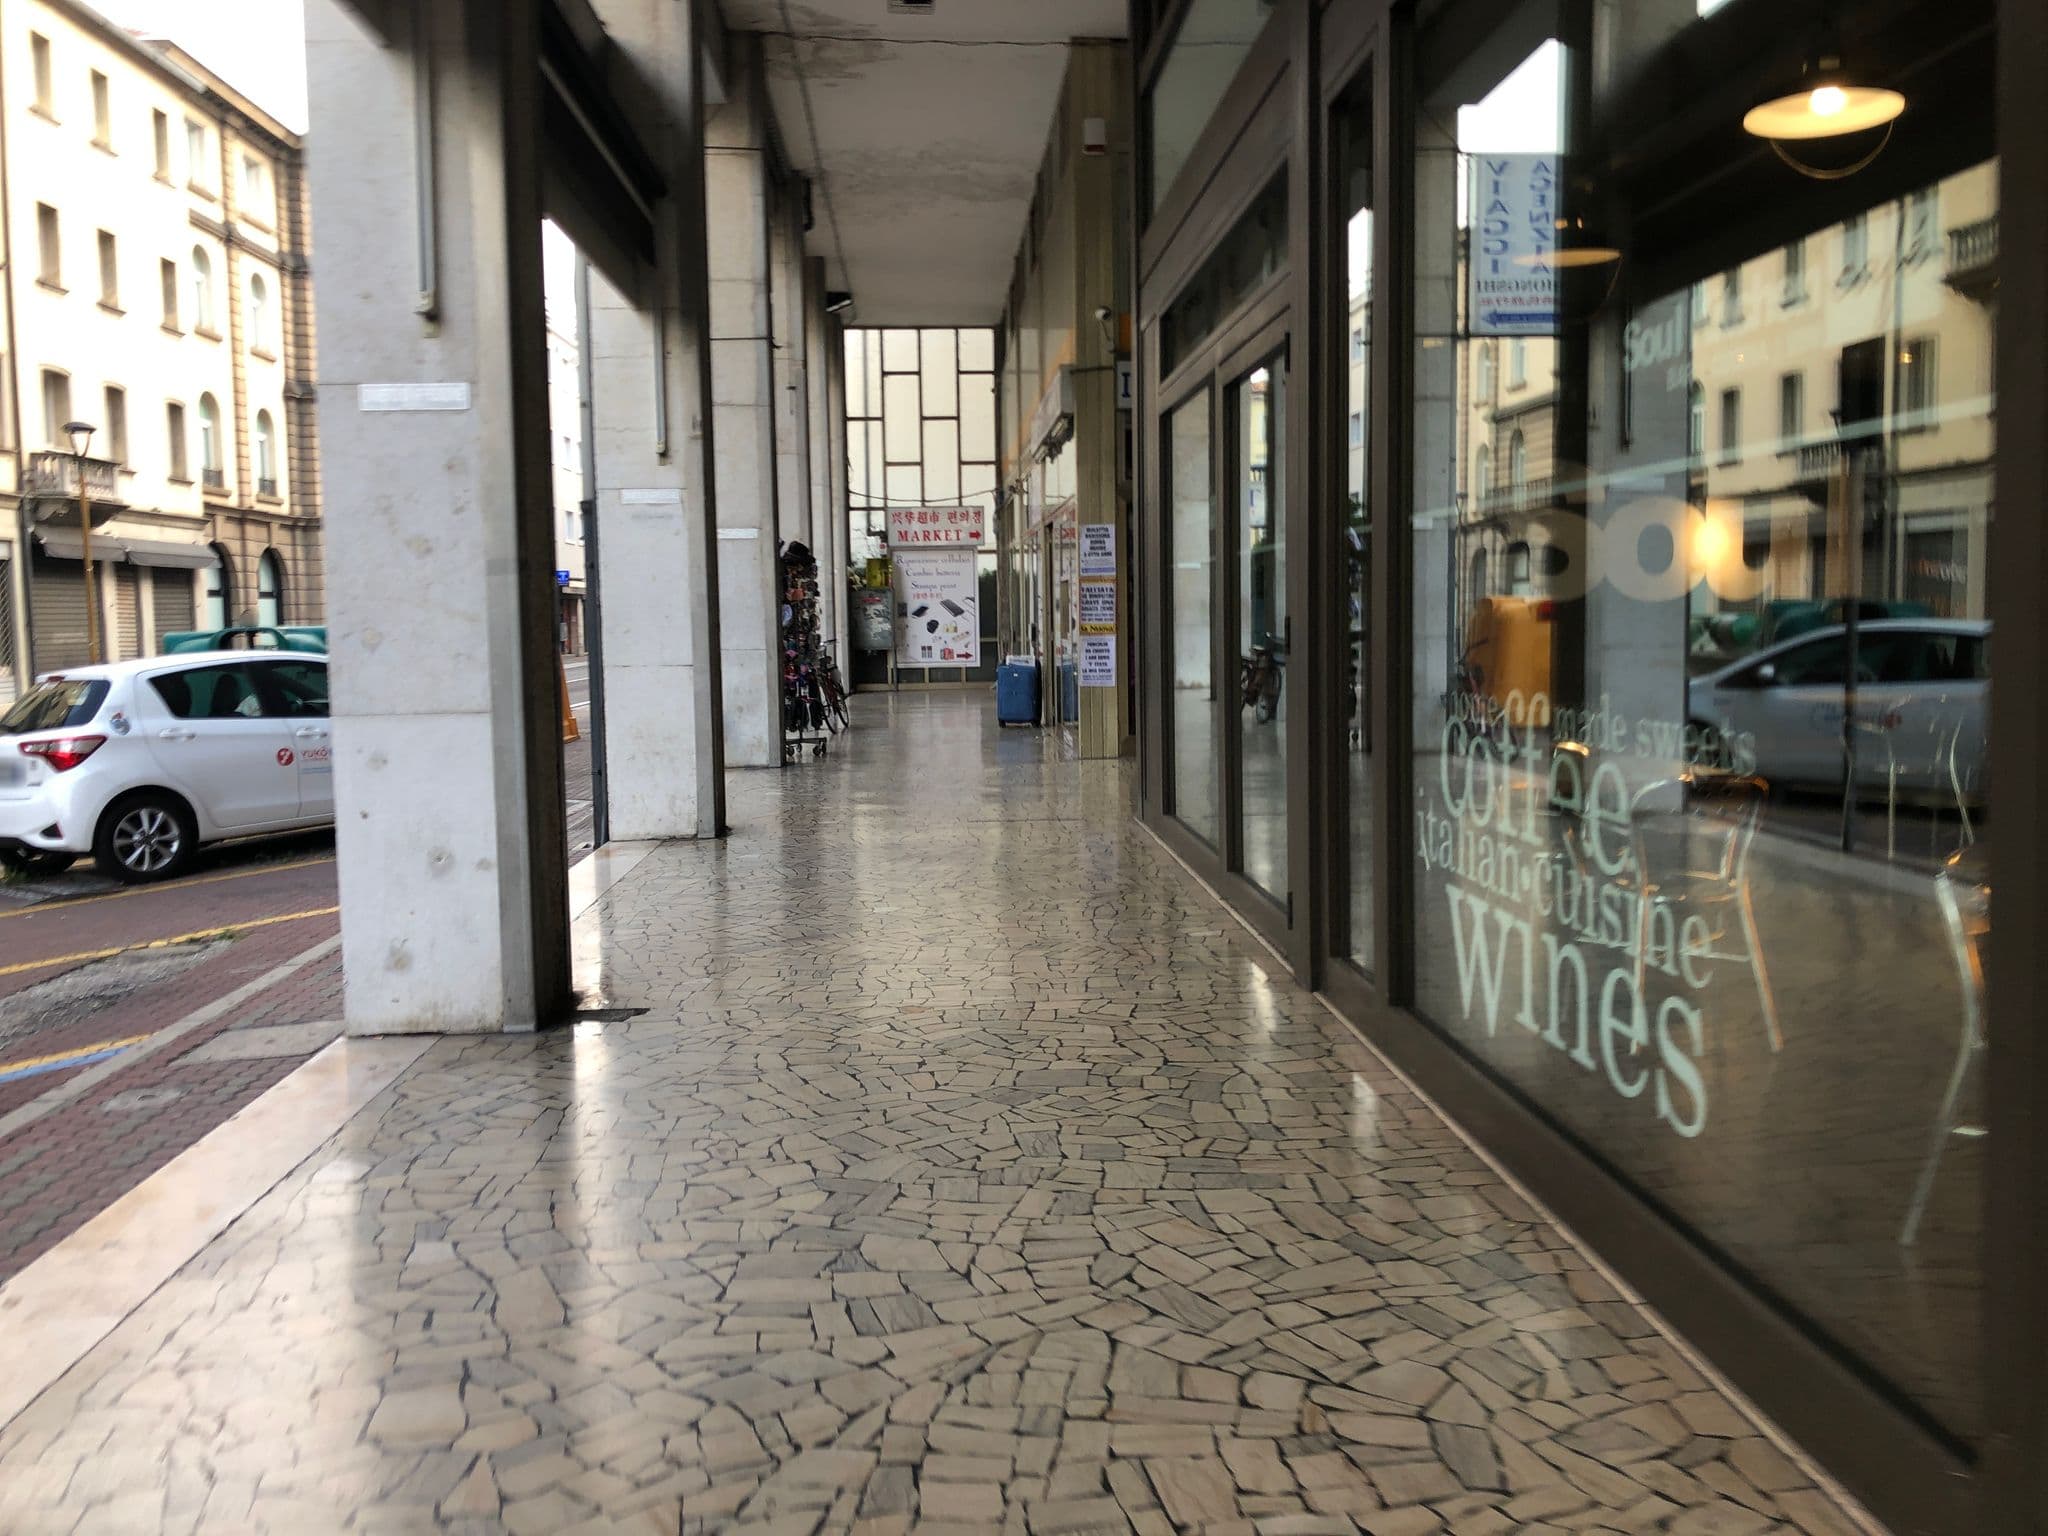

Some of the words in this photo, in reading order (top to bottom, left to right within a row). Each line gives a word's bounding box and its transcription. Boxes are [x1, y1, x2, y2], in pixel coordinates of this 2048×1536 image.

[897, 529, 962, 542] MARKET
[1440, 688, 1632, 876] coffee
[1553, 693, 1629, 753] made
[1636, 717, 1758, 779] sweets
[1445, 884, 1708, 1138] wines
